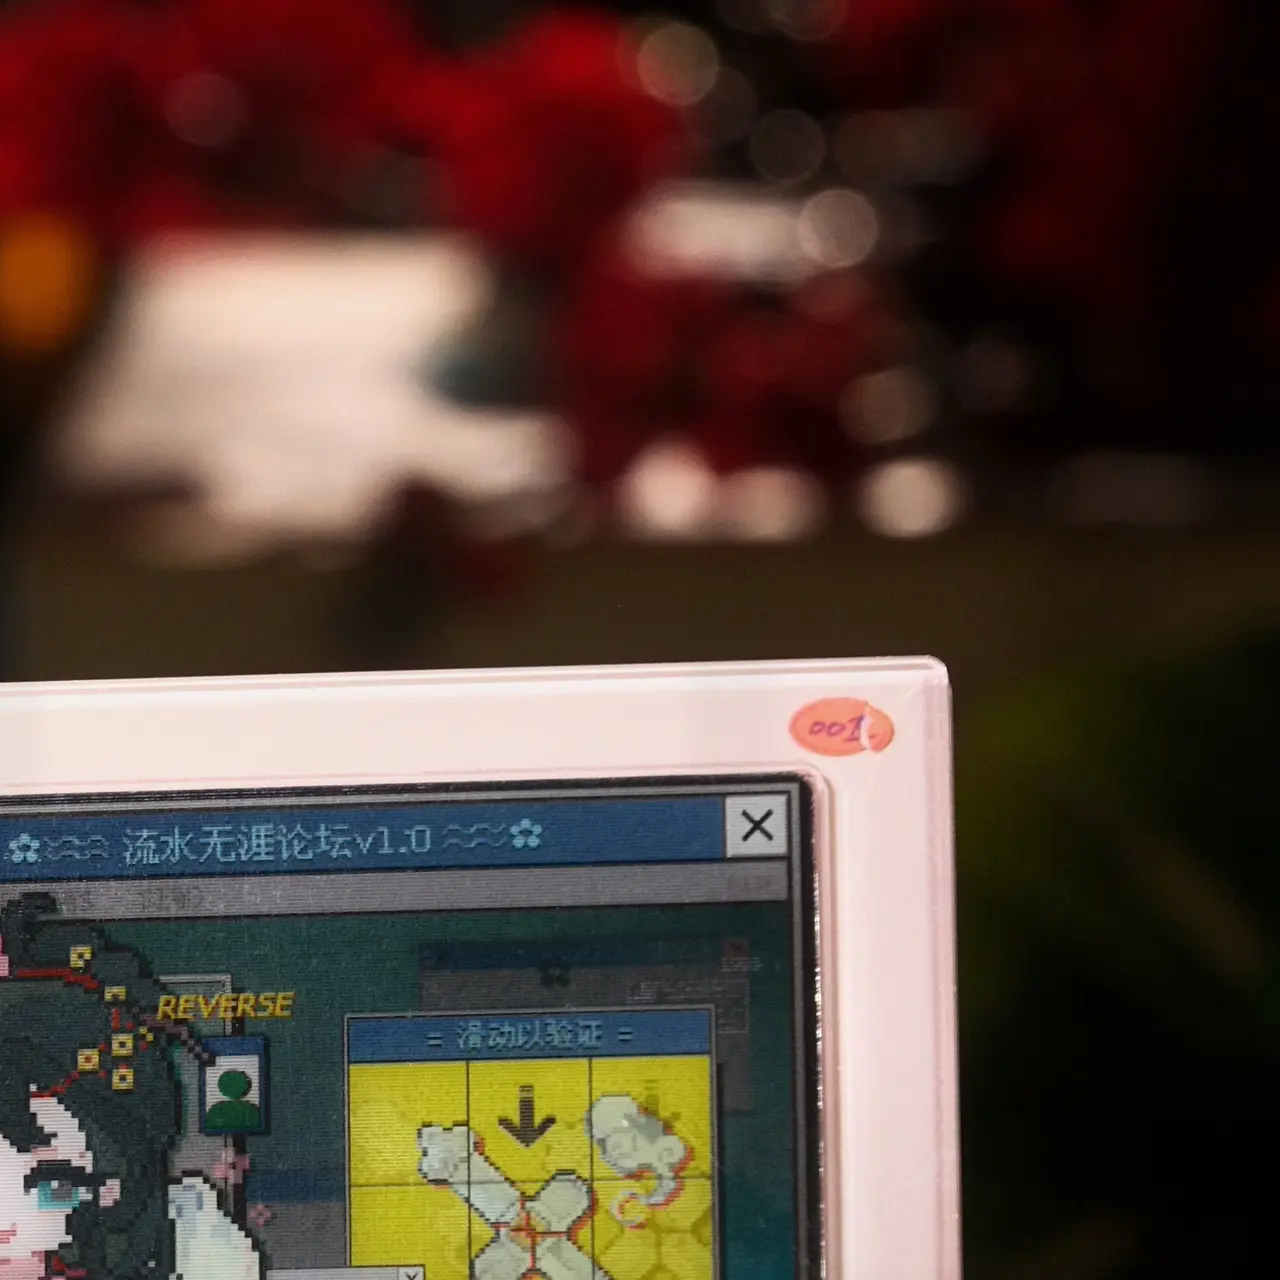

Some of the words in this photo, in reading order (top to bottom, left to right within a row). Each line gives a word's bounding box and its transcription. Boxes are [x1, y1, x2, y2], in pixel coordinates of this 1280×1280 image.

[157, 992, 296, 1020] REVERSE
[456, 1018, 603, 1050] 滑动以验证
